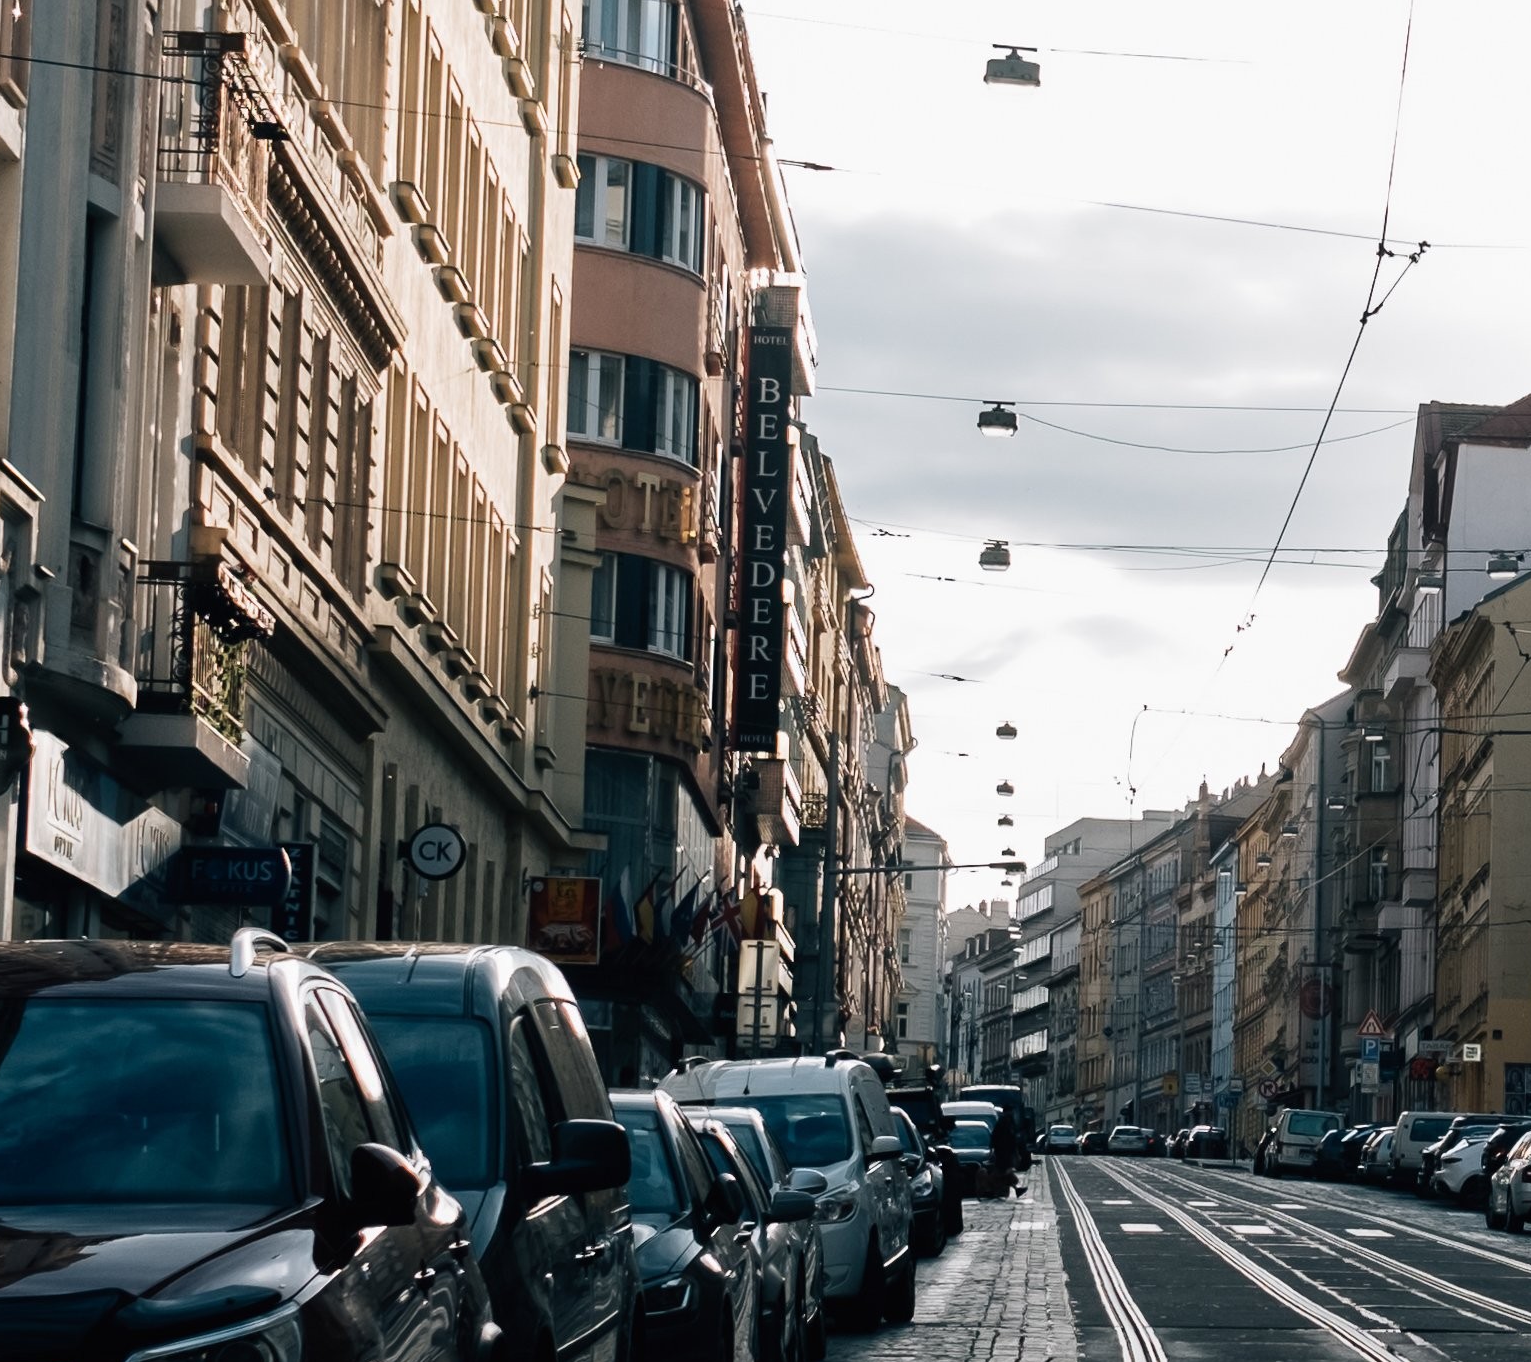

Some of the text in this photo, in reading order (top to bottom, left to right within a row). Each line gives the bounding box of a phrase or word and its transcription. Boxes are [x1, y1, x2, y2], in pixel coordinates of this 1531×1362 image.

[753, 334, 788, 347] HOTEL
[747, 377, 782, 701] BELVEDERE
[419, 841, 452, 862] CK
